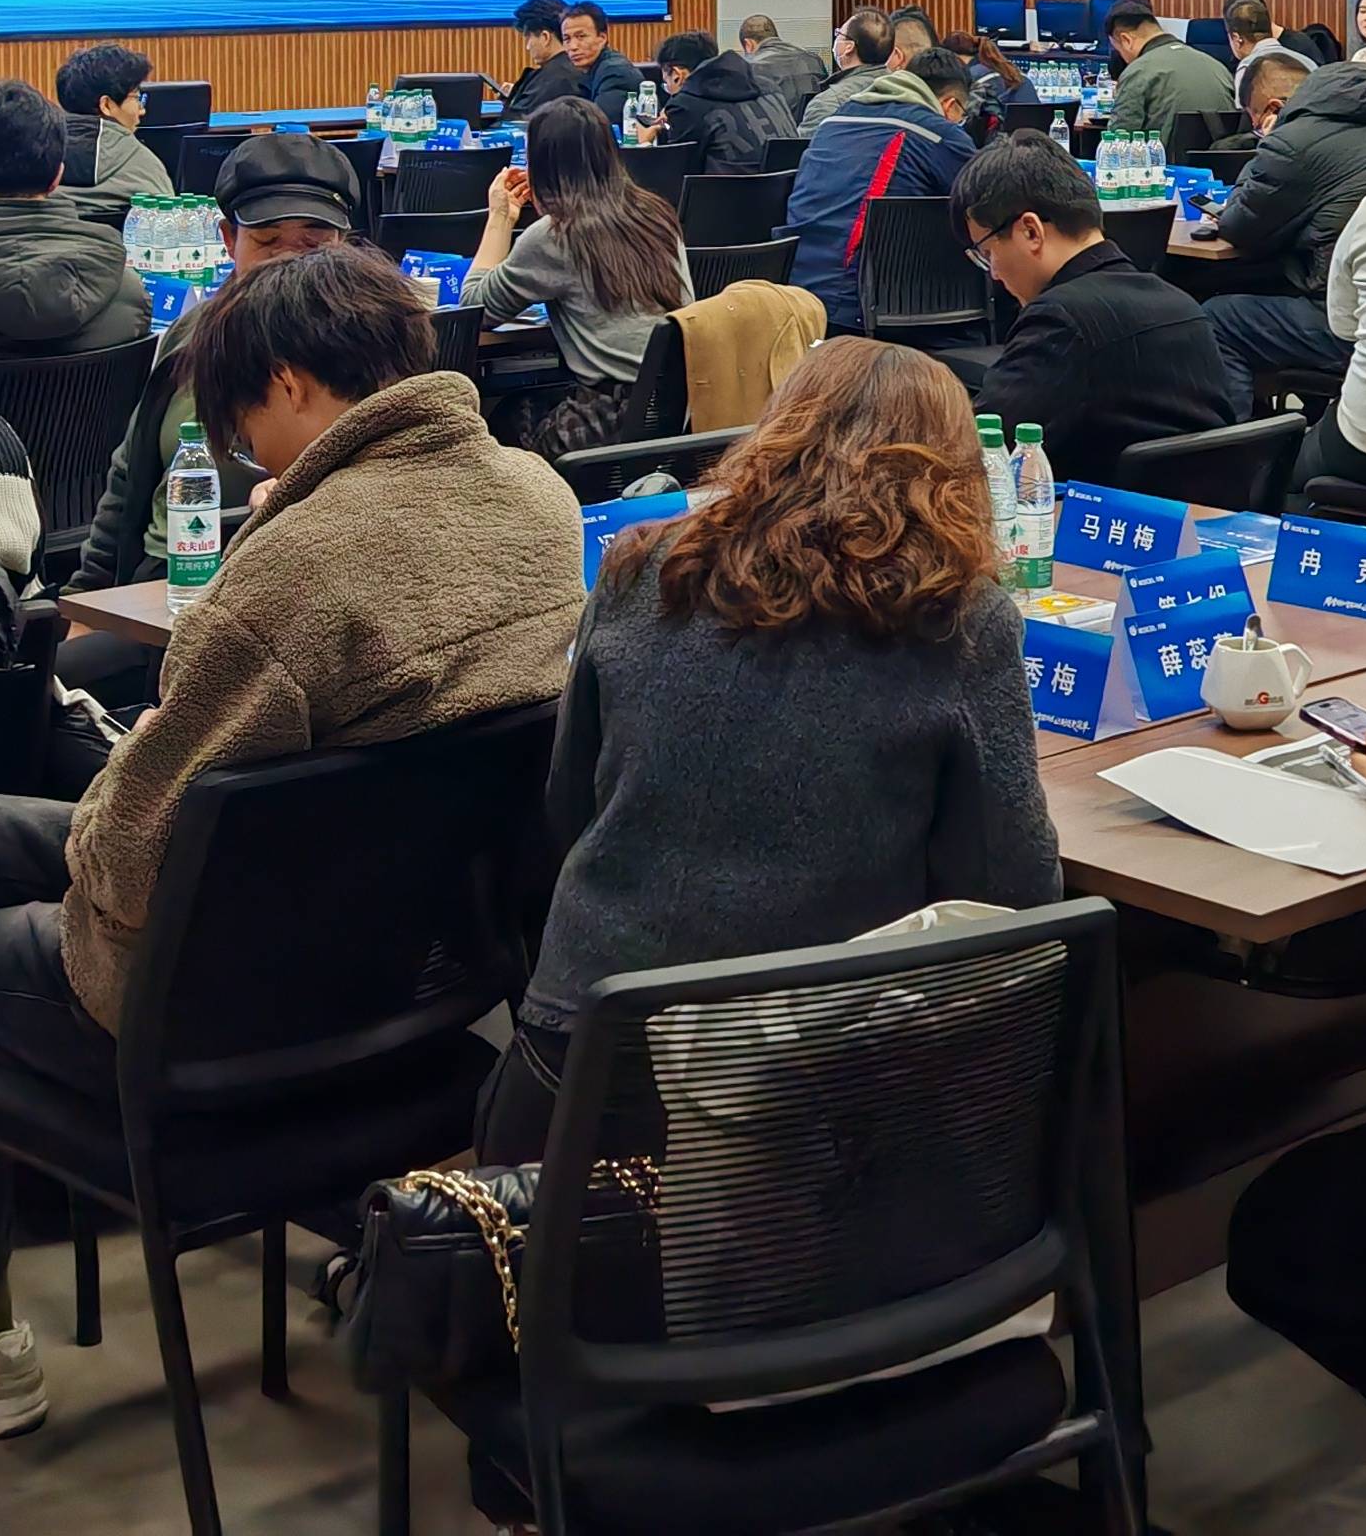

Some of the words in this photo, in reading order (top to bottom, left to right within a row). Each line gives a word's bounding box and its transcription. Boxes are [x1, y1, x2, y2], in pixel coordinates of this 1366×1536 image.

[1080, 513, 1156, 551] 马肖梅
[1157, 631, 1233, 678] 薛蕊
